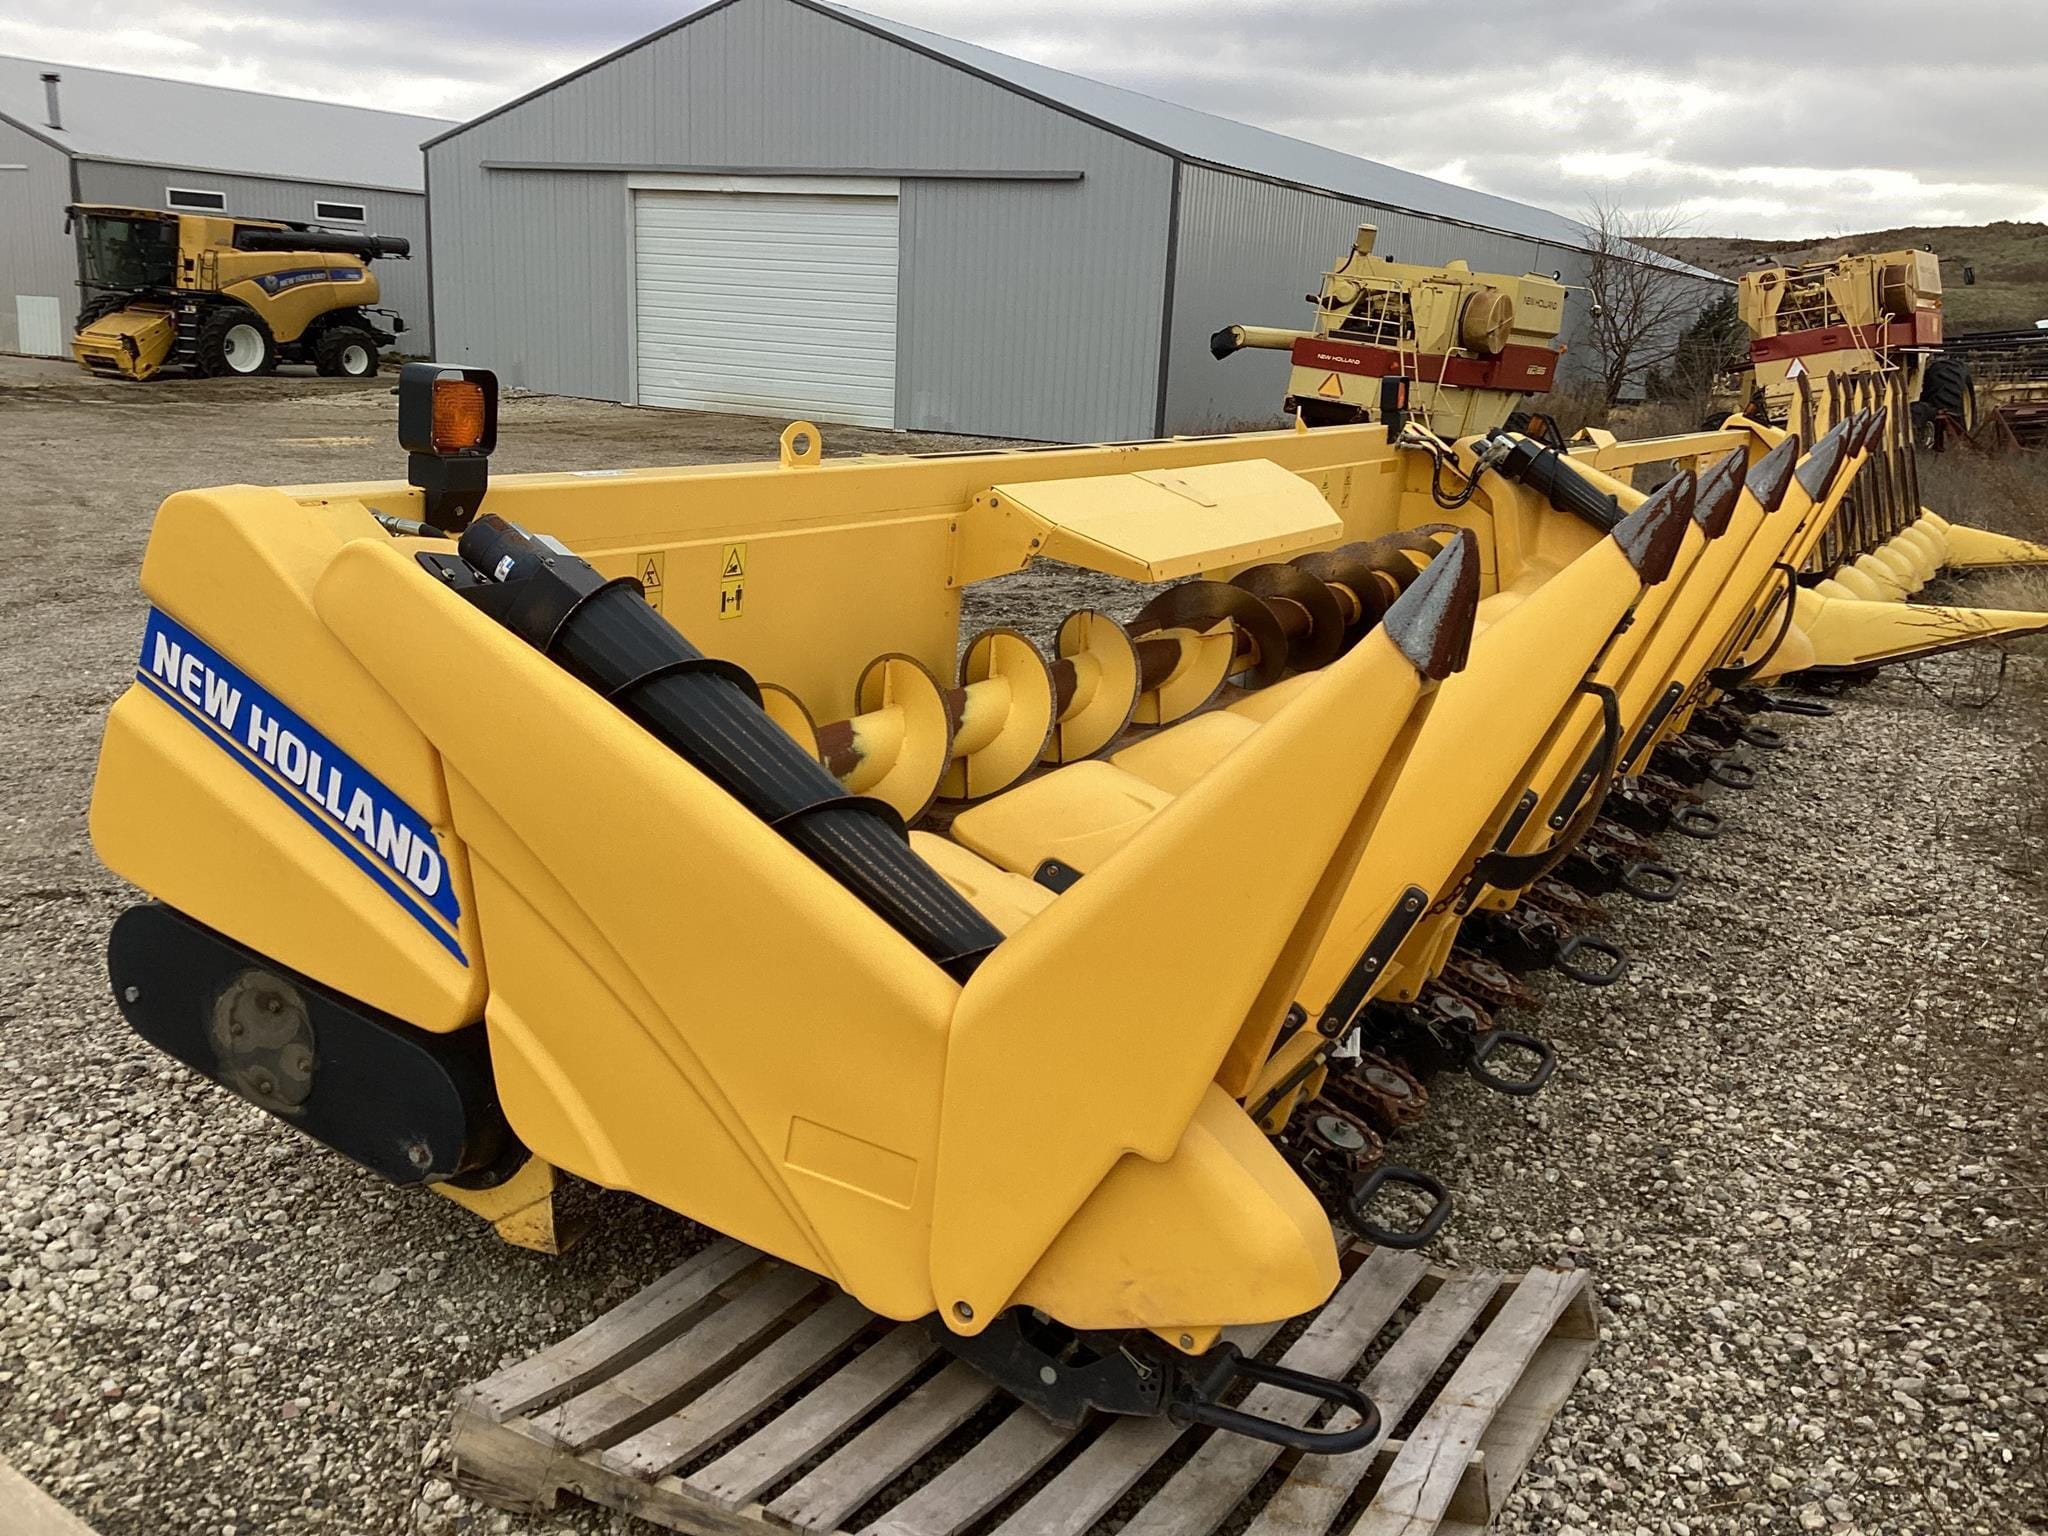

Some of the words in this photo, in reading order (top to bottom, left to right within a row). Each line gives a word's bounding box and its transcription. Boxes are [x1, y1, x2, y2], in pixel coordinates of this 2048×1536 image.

[1332, 356, 1361, 365] HOLLAND
[154, 631, 242, 730] NEW
[247, 703, 441, 896] HOLLAND
